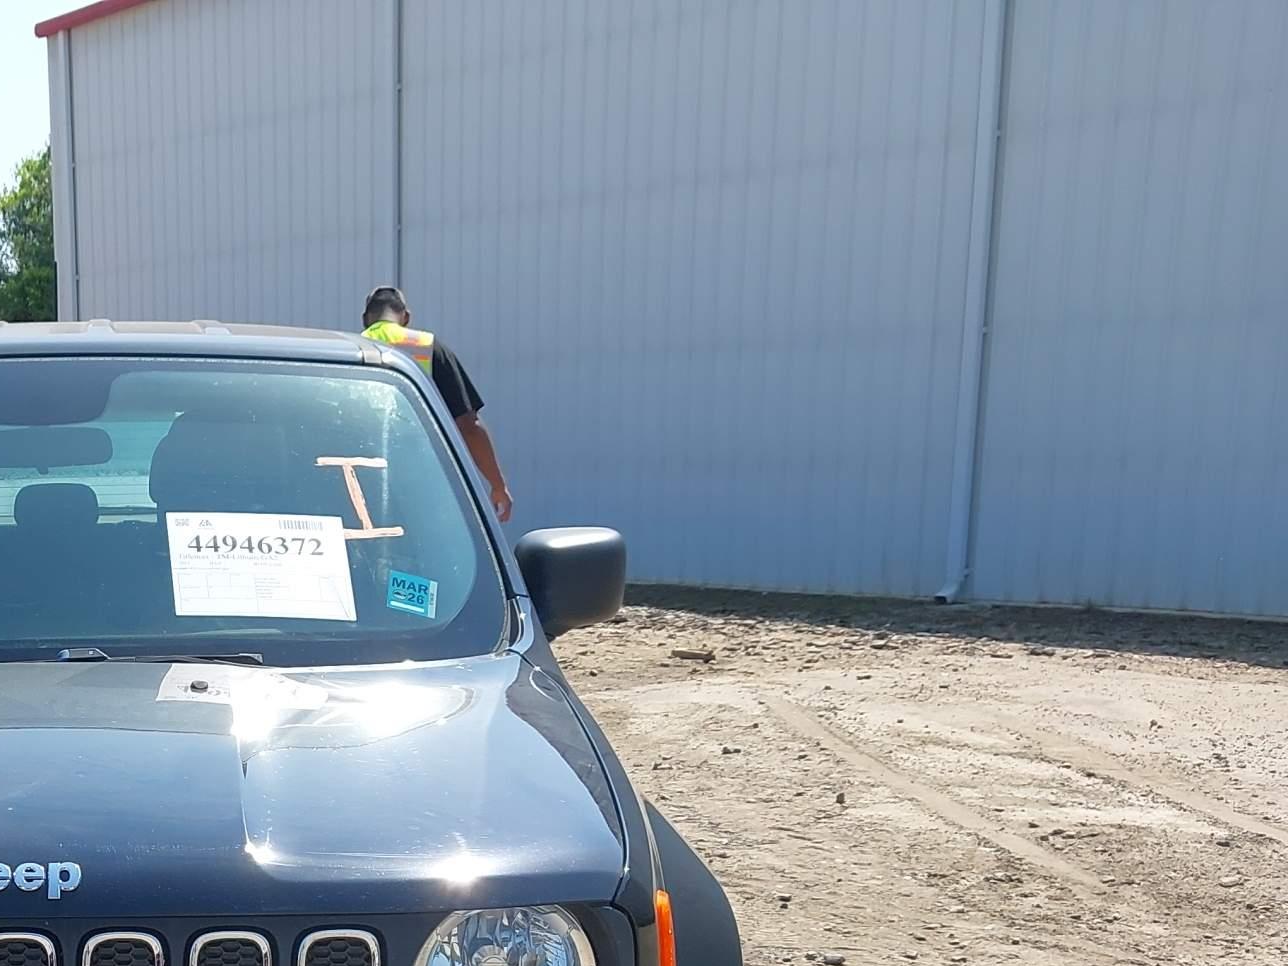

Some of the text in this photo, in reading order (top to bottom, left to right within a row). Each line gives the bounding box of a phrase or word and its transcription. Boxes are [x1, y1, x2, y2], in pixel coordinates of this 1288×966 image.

[187, 534, 325, 556] 44946372
[391, 576, 429, 595] MAR
[407, 592, 425, 605] 26
